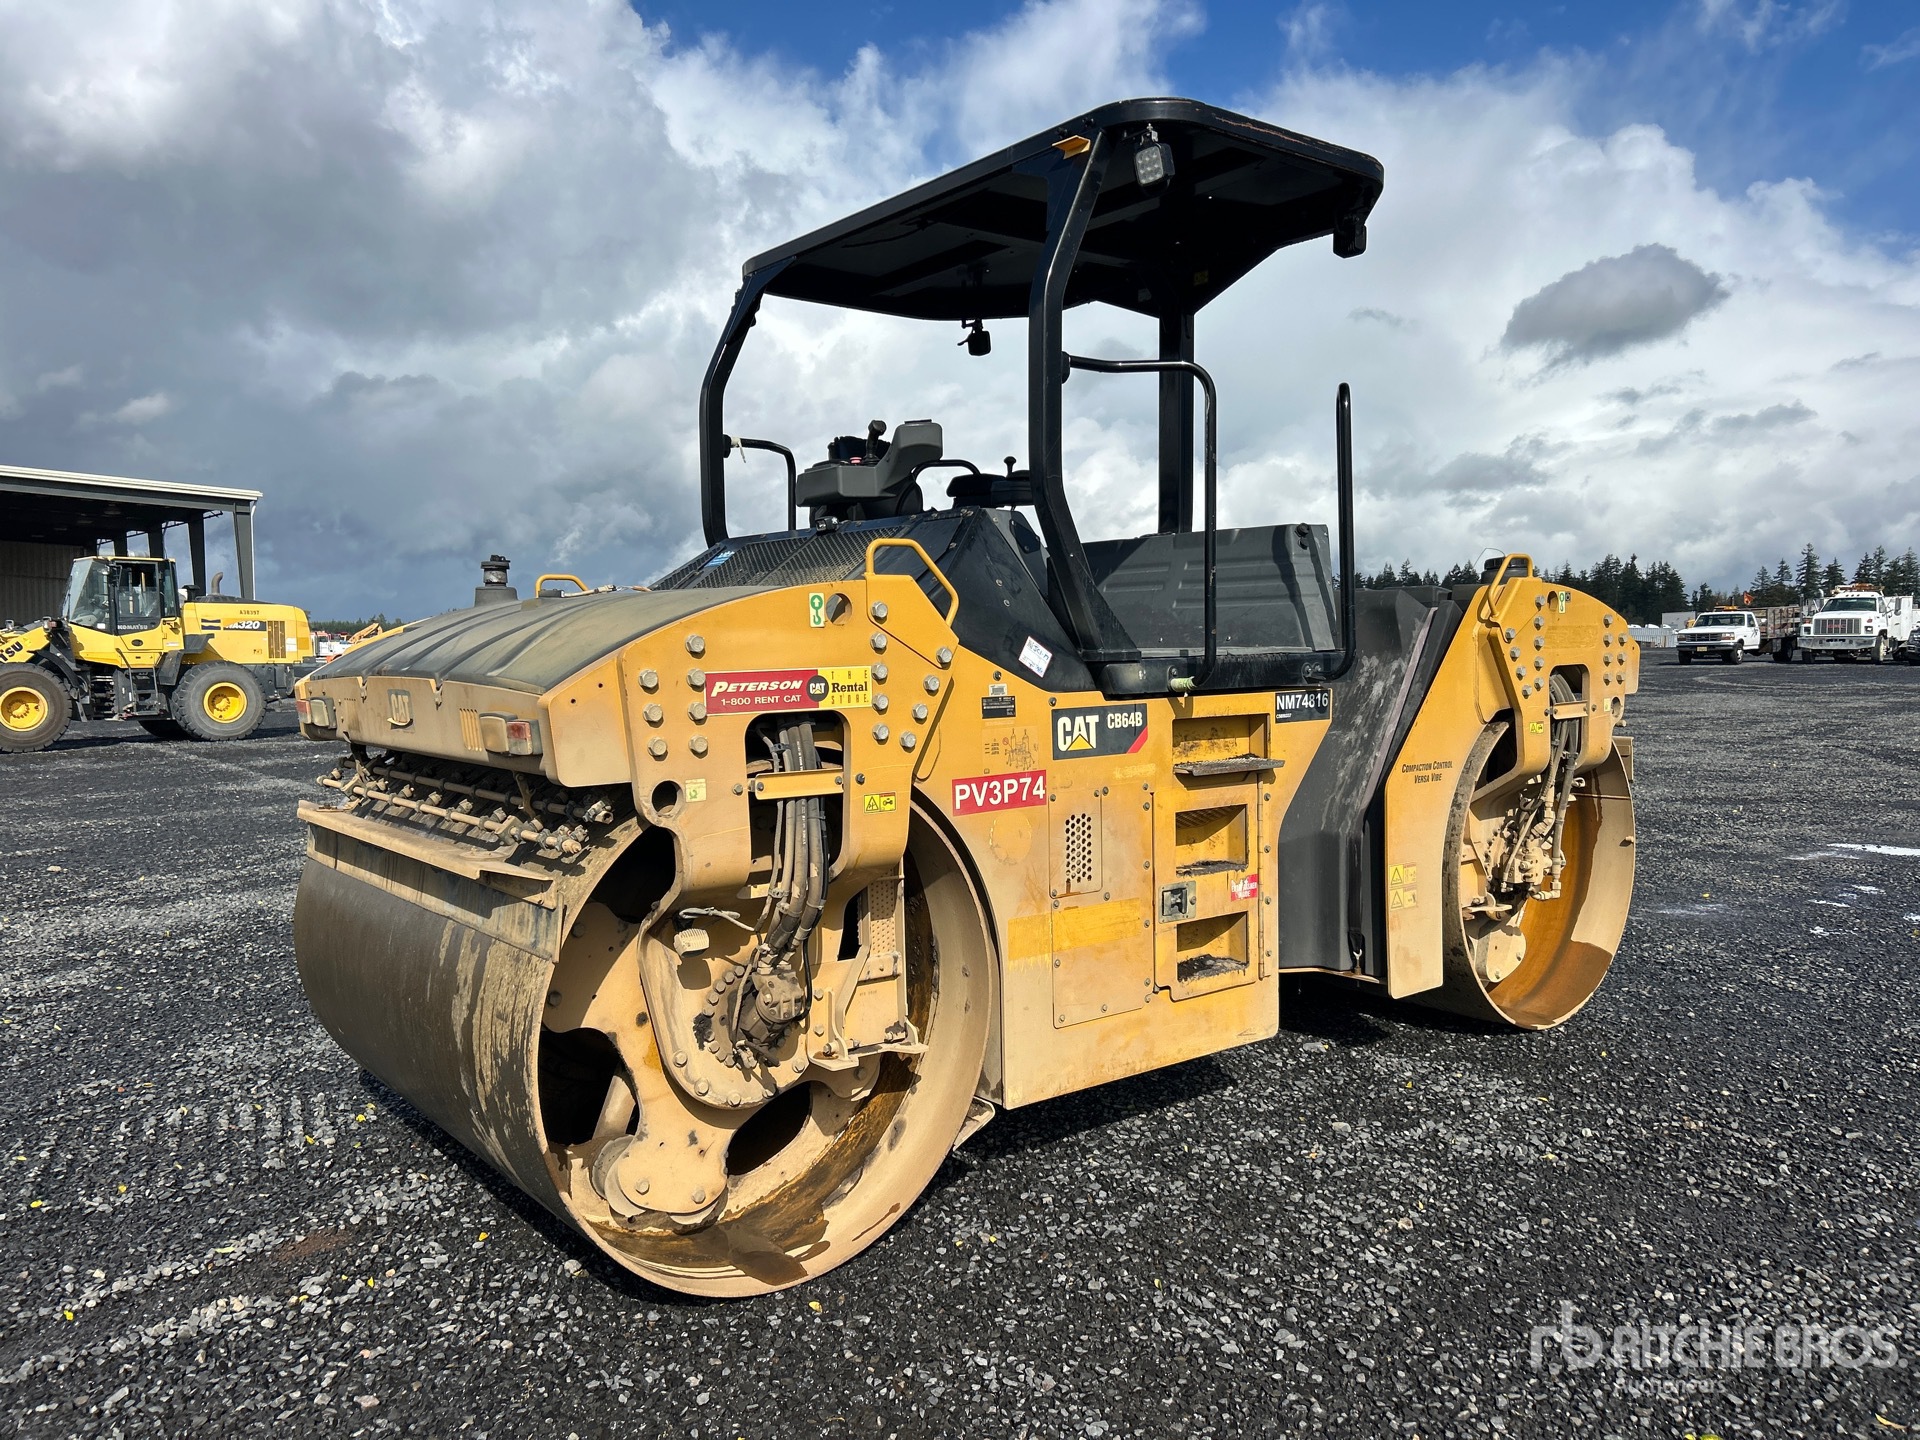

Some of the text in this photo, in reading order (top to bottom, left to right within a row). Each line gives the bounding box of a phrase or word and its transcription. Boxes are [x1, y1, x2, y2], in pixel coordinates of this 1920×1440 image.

[711, 680, 803, 697] PETERSON
[809, 682, 826, 695] CAT
[831, 681, 868, 693] Rental
[390, 693, 410, 724] CAT
[721, 694, 802, 706] 1-800 RENT CAT
[1276, 692, 1329, 710] NM74816
[1107, 711, 1143, 729] CB64B
[1057, 714, 1100, 752] CAT
[1401, 760, 1453, 773] COMPACTION CONTROL
[1414, 772, 1442, 784] VERSA VIBE
[954, 775, 1046, 810] PV3P74
